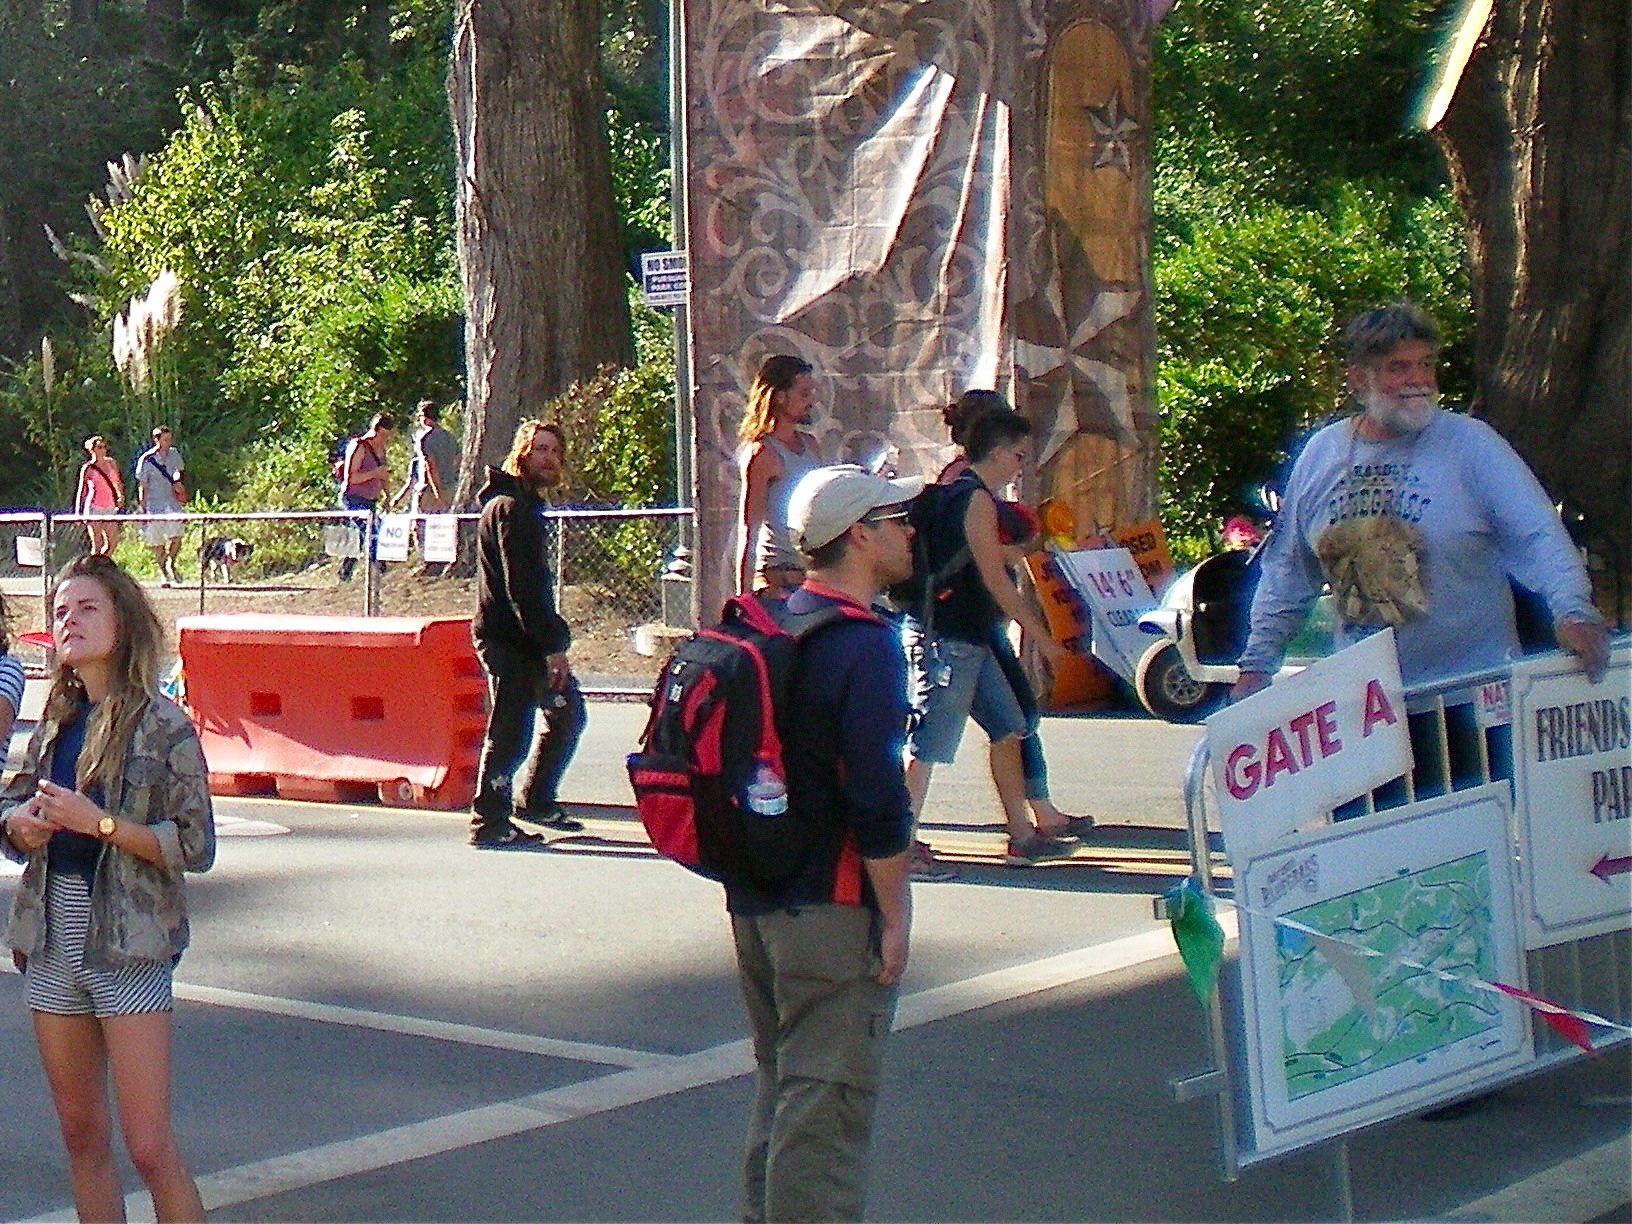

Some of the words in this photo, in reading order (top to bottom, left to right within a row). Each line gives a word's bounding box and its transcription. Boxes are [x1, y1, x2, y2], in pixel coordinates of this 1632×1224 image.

[385, 527, 403, 539] NO
[1225, 701, 1342, 802] GATE
[1361, 679, 1397, 737] A
[1536, 696, 1631, 762] FRIENDS
